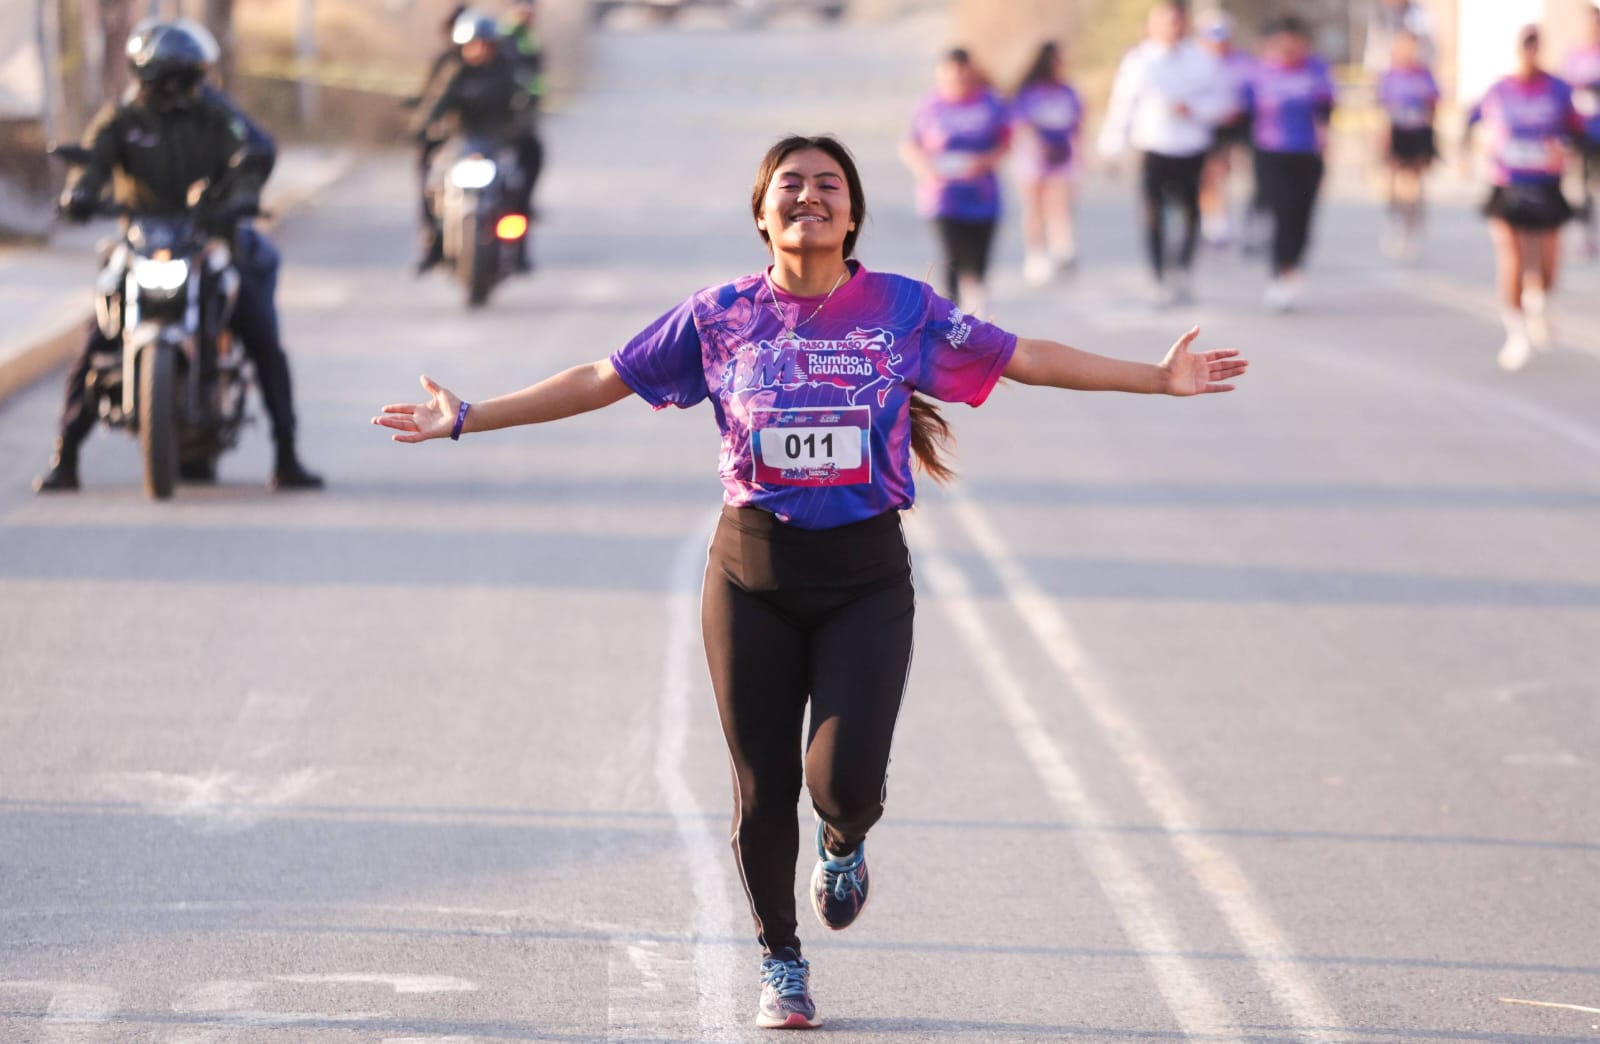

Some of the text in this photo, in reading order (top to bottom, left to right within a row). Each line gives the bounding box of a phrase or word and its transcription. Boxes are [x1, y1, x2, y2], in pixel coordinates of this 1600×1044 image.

[800, 340, 862, 349] PASO A PASO
[808, 353, 858, 365] Rumbo
[808, 363, 873, 376] IGUALDAD
[785, 433, 833, 459] 011
